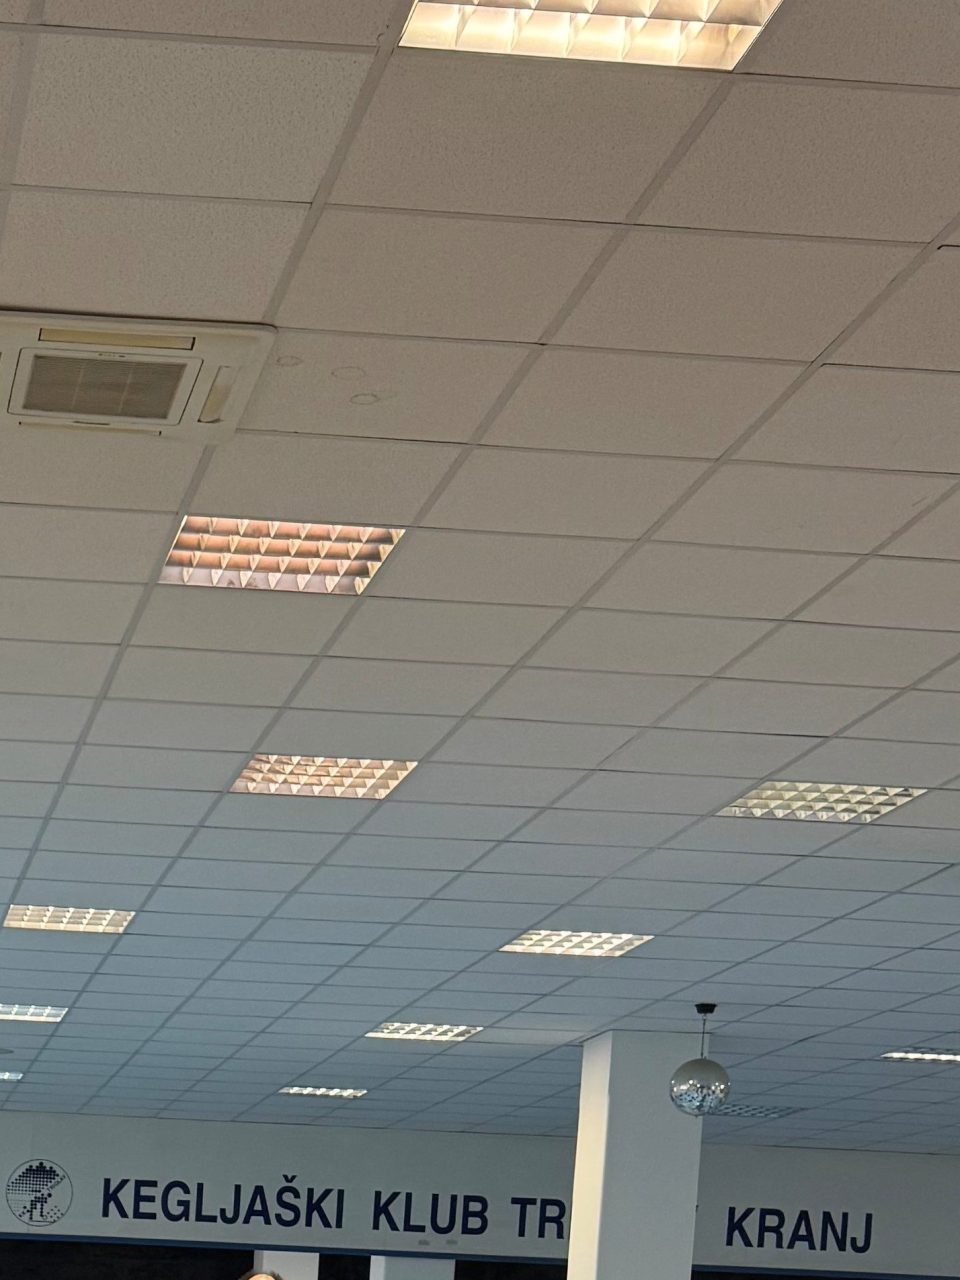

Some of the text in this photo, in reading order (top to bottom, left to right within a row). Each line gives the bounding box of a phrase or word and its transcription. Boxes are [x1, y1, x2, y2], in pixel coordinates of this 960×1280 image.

[100, 1175, 874, 1254] KEGLJAŠKI KLUB TR KRANJ
